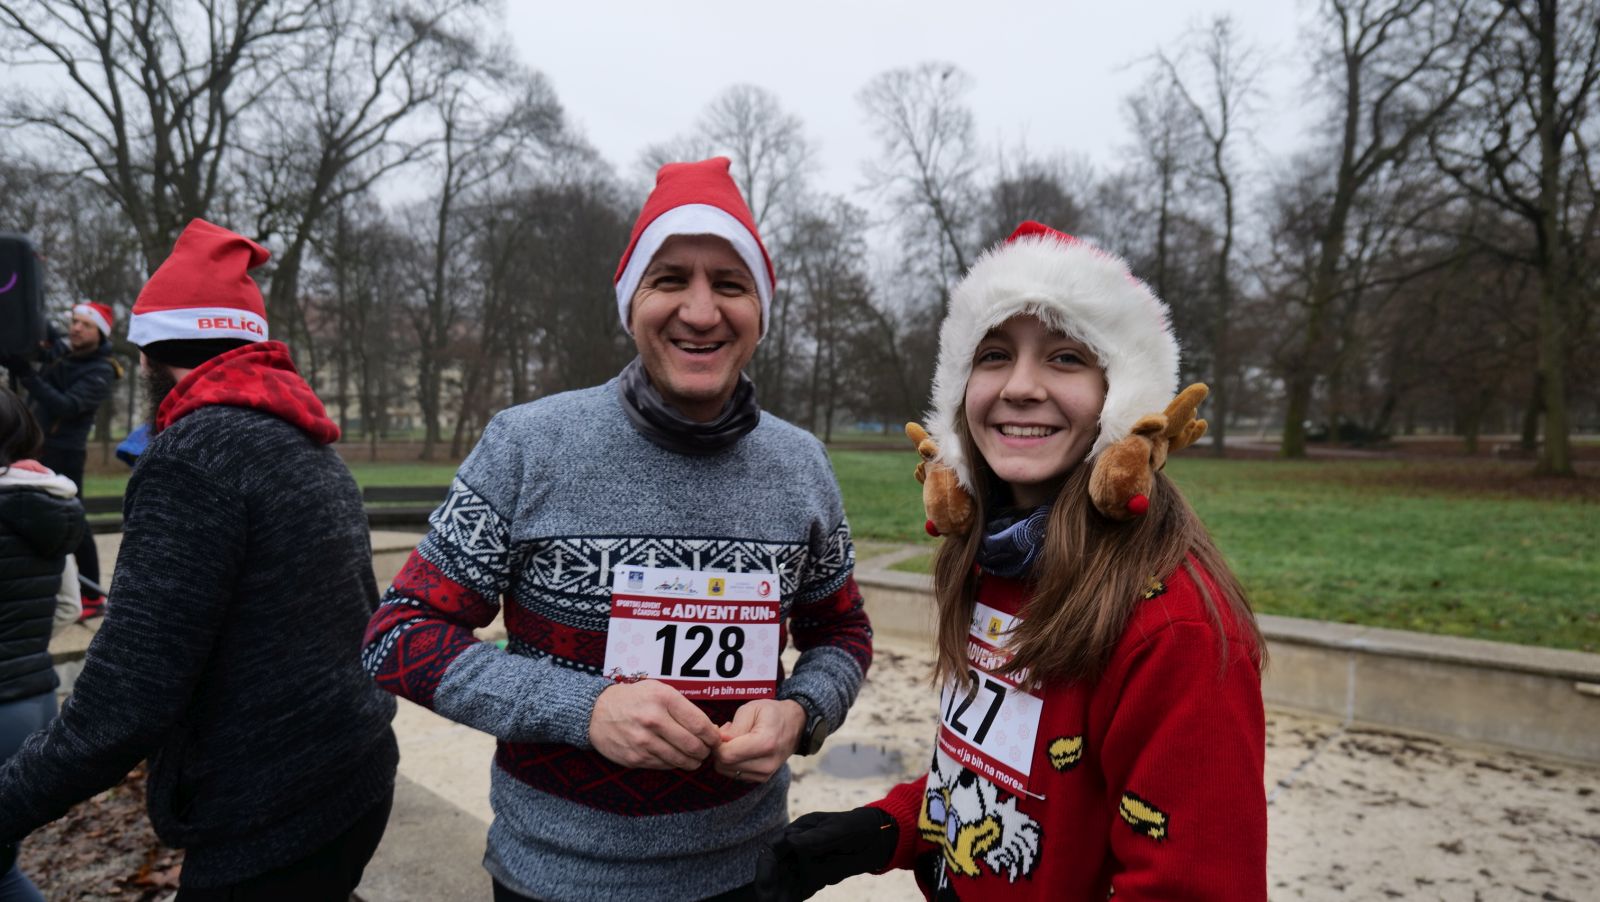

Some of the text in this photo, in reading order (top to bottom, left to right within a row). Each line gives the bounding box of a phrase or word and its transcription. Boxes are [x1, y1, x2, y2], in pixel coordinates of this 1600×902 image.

[655, 624, 745, 679] 128
[711, 686, 720, 697] ja
[721, 686, 734, 695] bih
[735, 687, 745, 695] na
[944, 669, 1007, 746] 127
[971, 753, 984, 769] bih
[984, 763, 995, 776] na
